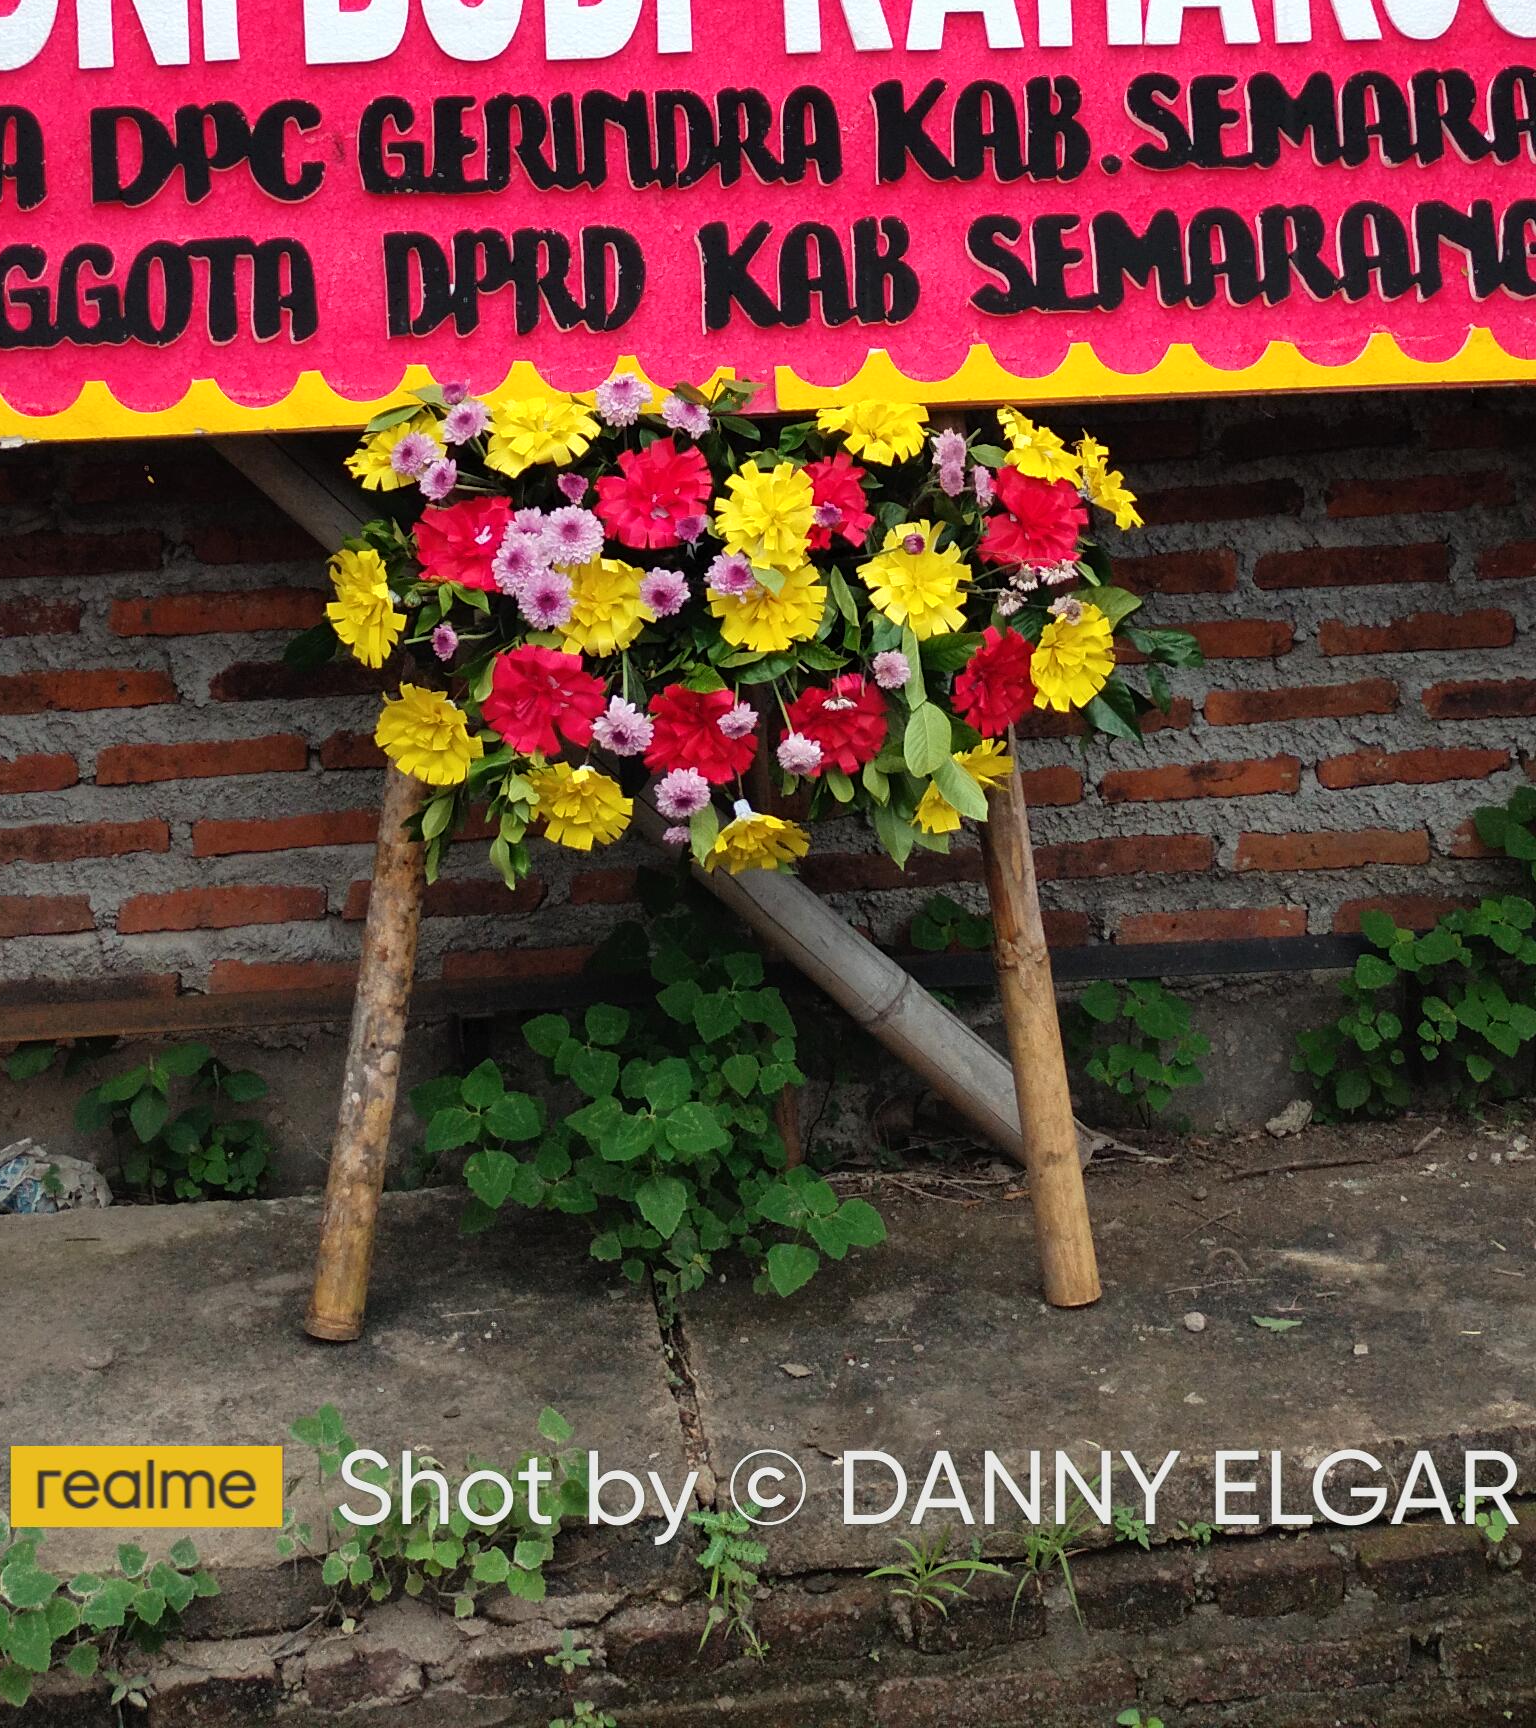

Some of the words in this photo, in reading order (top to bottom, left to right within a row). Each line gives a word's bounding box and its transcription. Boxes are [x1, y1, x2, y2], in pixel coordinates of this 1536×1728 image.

[90, 100, 325, 210] DPC
[358, 86, 842, 196] GERINDRA
[383, 226, 645, 336] DPRD
[698, 216, 919, 330] KAB
